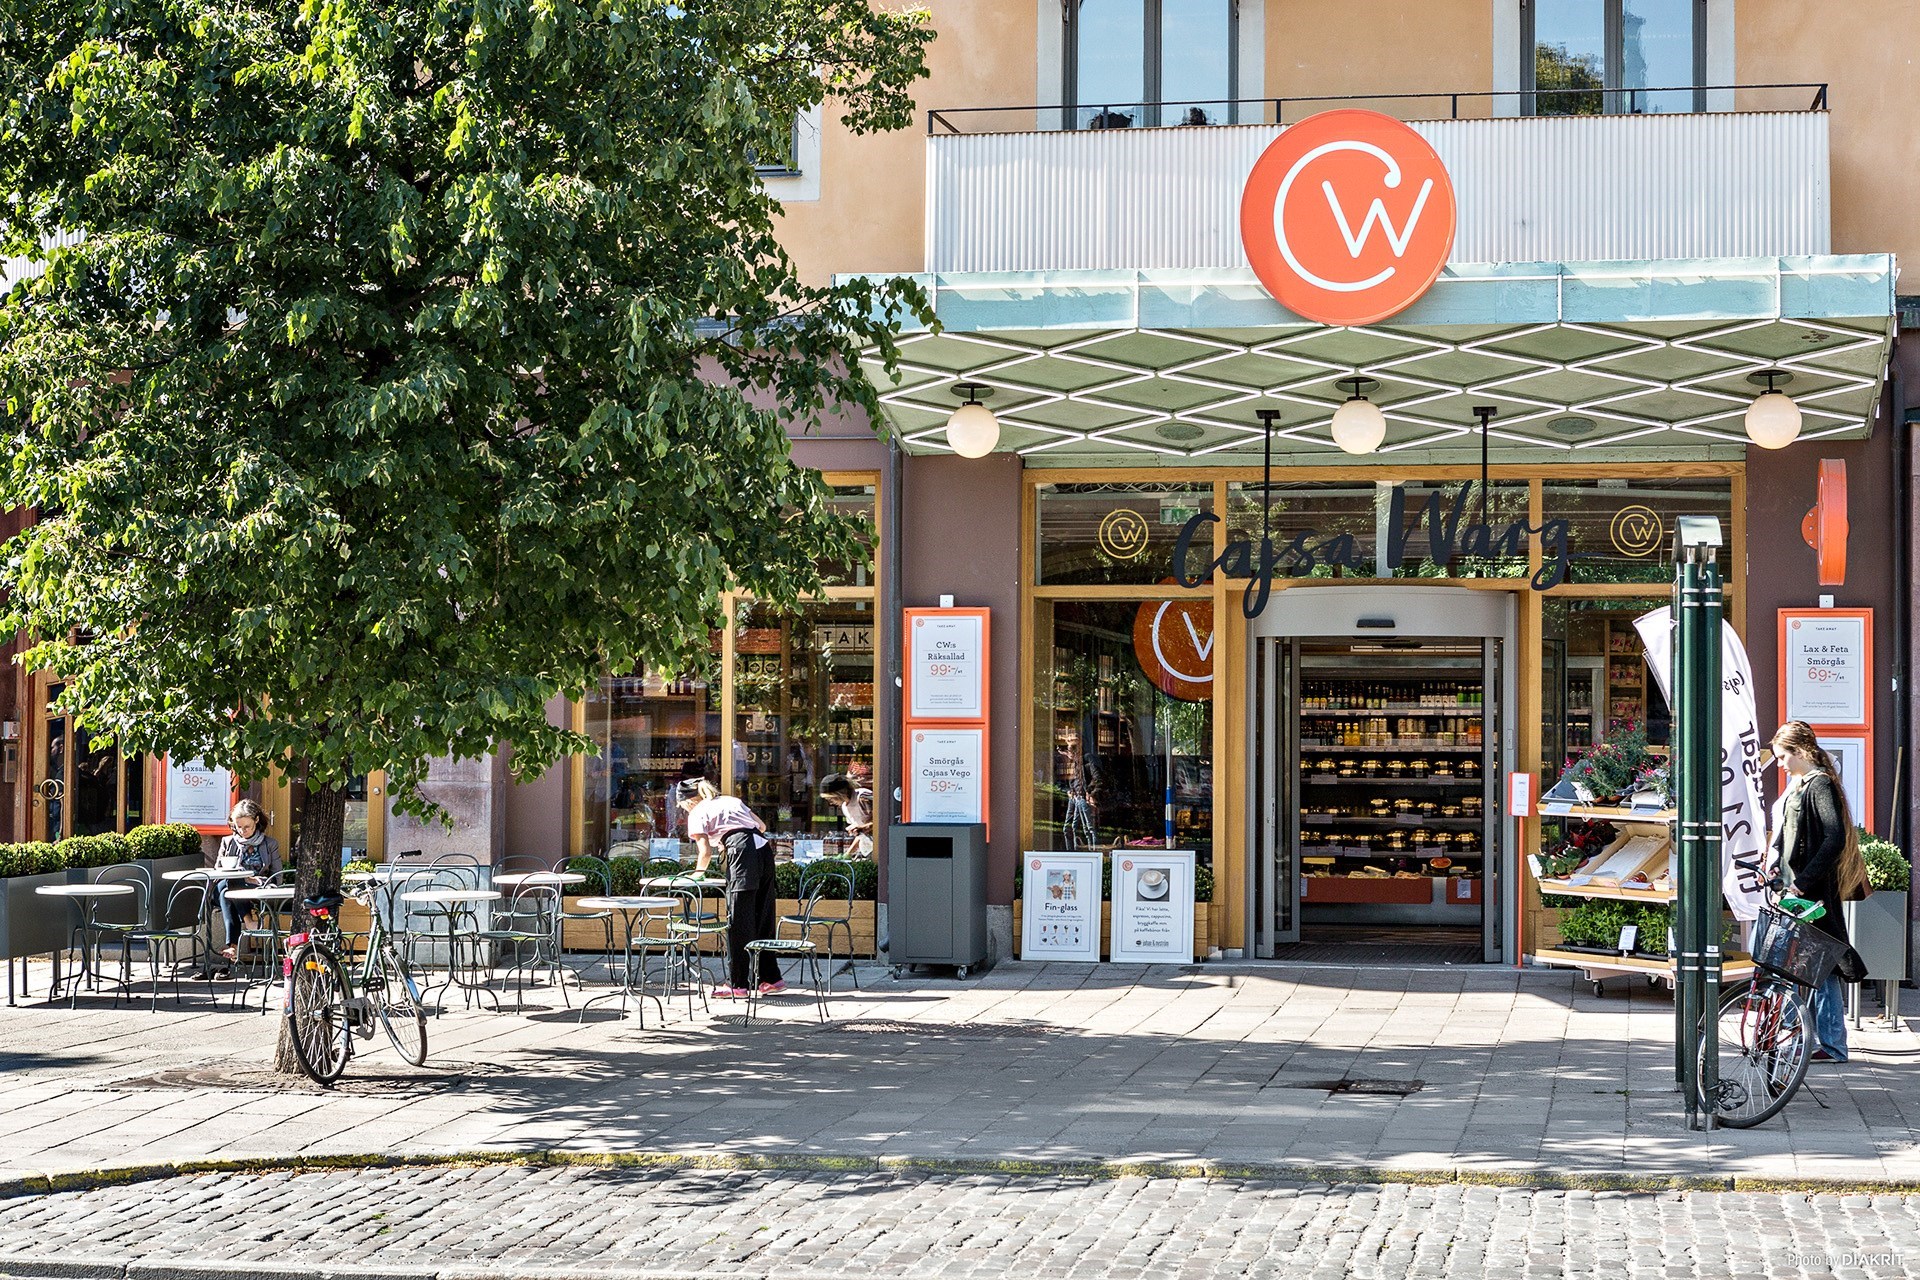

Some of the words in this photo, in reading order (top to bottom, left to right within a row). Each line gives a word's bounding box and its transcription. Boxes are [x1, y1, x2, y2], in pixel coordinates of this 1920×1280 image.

[1173, 512, 1363, 619] Cajsa
[1387, 479, 1606, 591] Warg
[1803, 645, 1819, 653] Lax
[1821, 645, 1828, 653] &
[1830, 645, 1849, 653] Feta
[1806, 657, 1846, 667] Smörgås
[929, 757, 965, 766] Smörgås
[922, 769, 948, 778] Cajsas
[950, 769, 971, 778] Vego
[1044, 902, 1078, 913] Fin-glass
